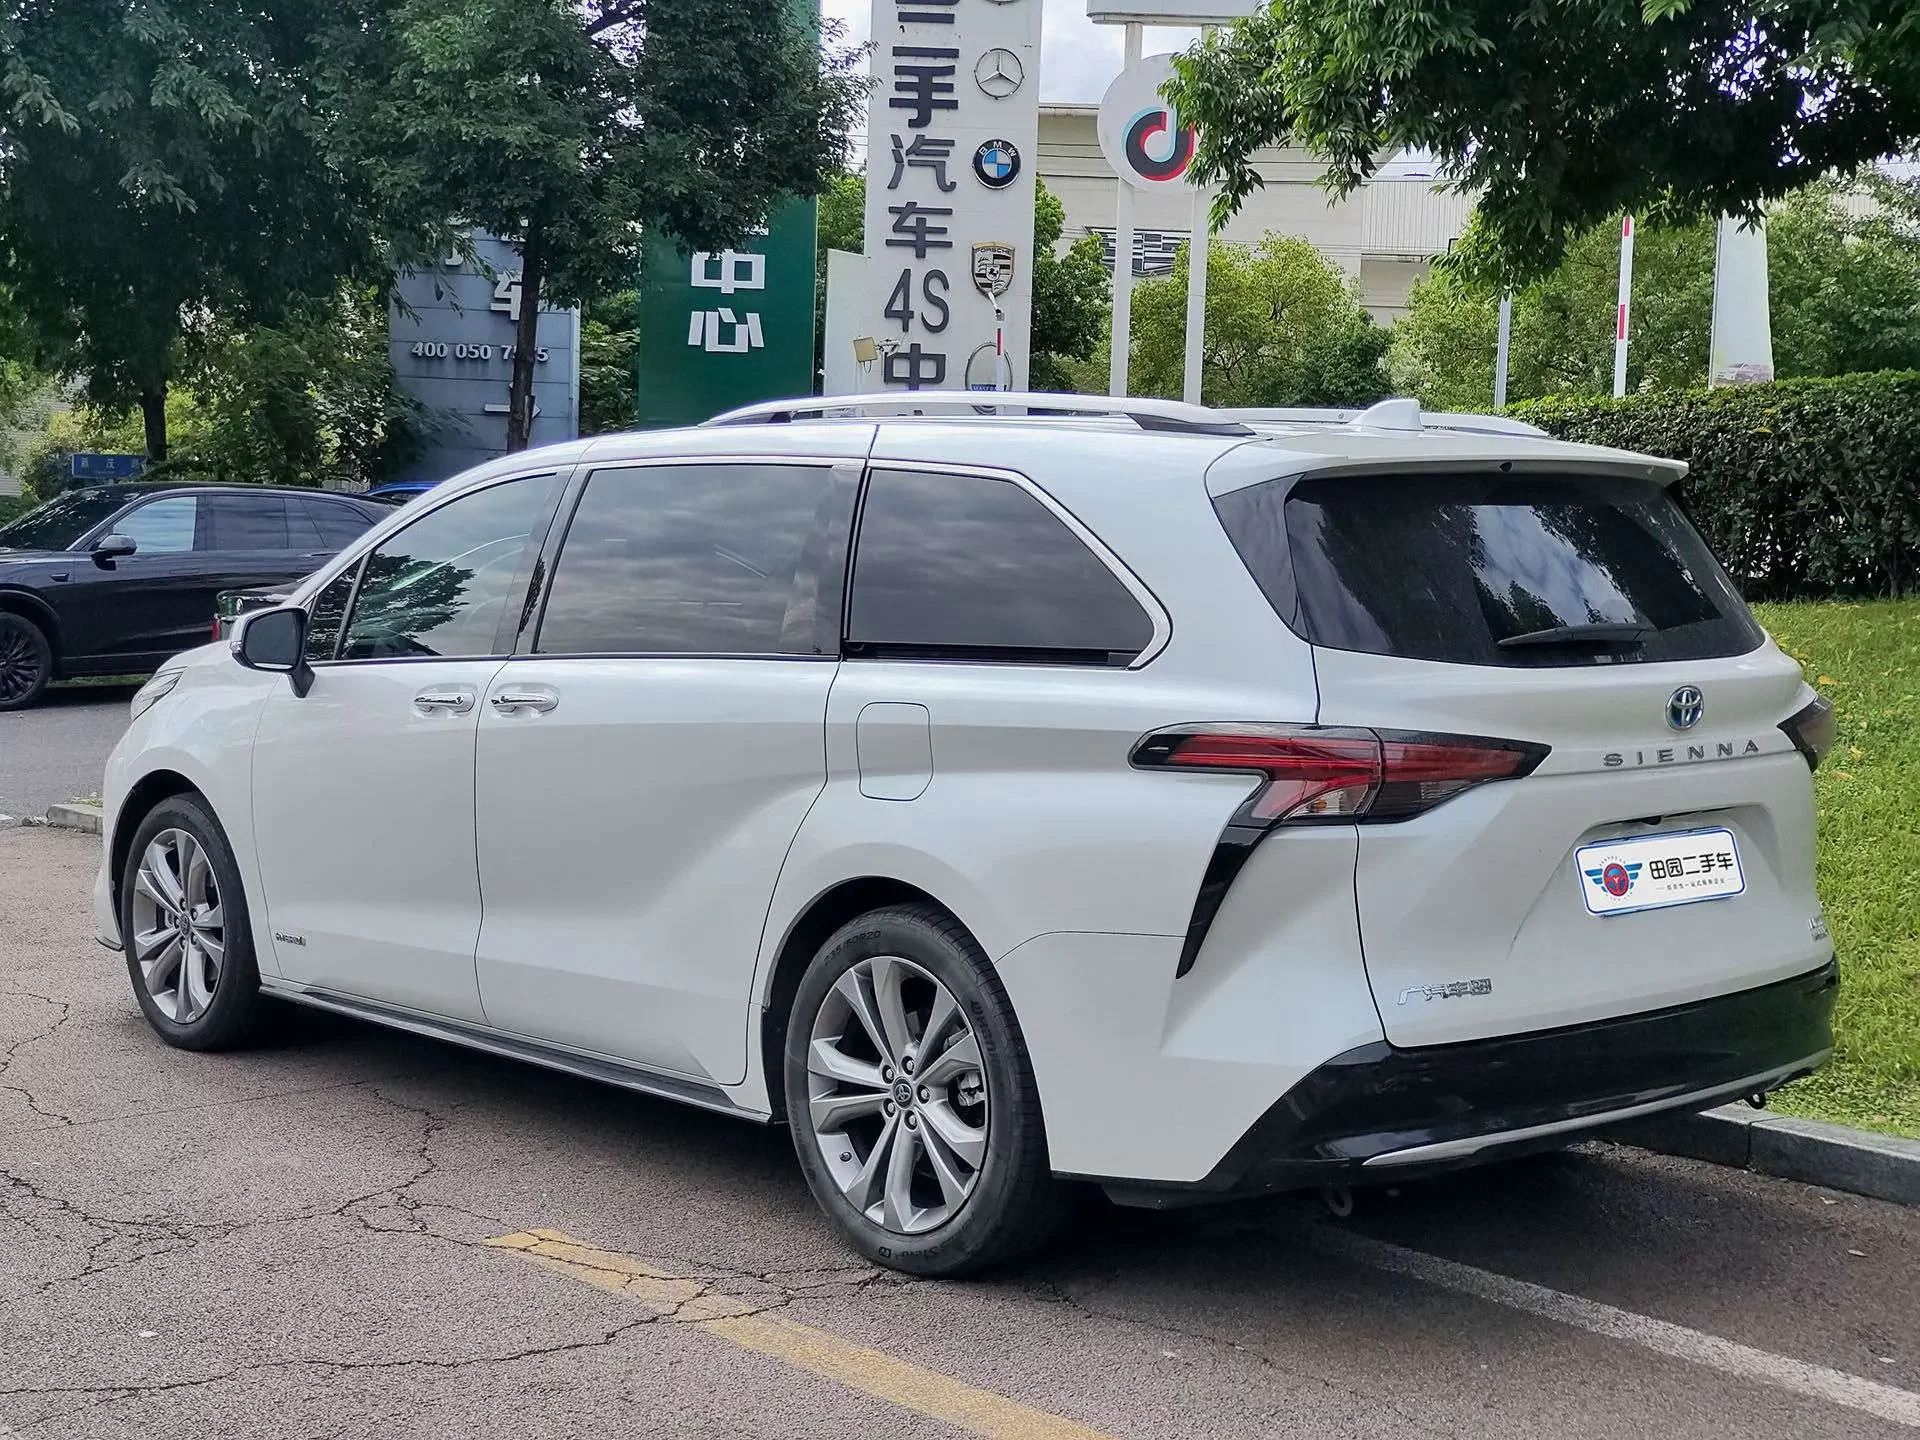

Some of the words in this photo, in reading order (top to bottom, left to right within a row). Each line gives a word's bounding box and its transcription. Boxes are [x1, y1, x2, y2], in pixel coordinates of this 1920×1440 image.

[979, 141, 1017, 157] BMW
[883, 0, 960, 415] 二手汽车4S中
[687, 248, 766, 353] 中心
[411, 341, 449, 359] 400
[455, 343, 492, 361] 050
[501, 344, 550, 363] 75
[1603, 739, 1760, 767] SIENNA
[1649, 852, 1734, 880] 田园二手车
